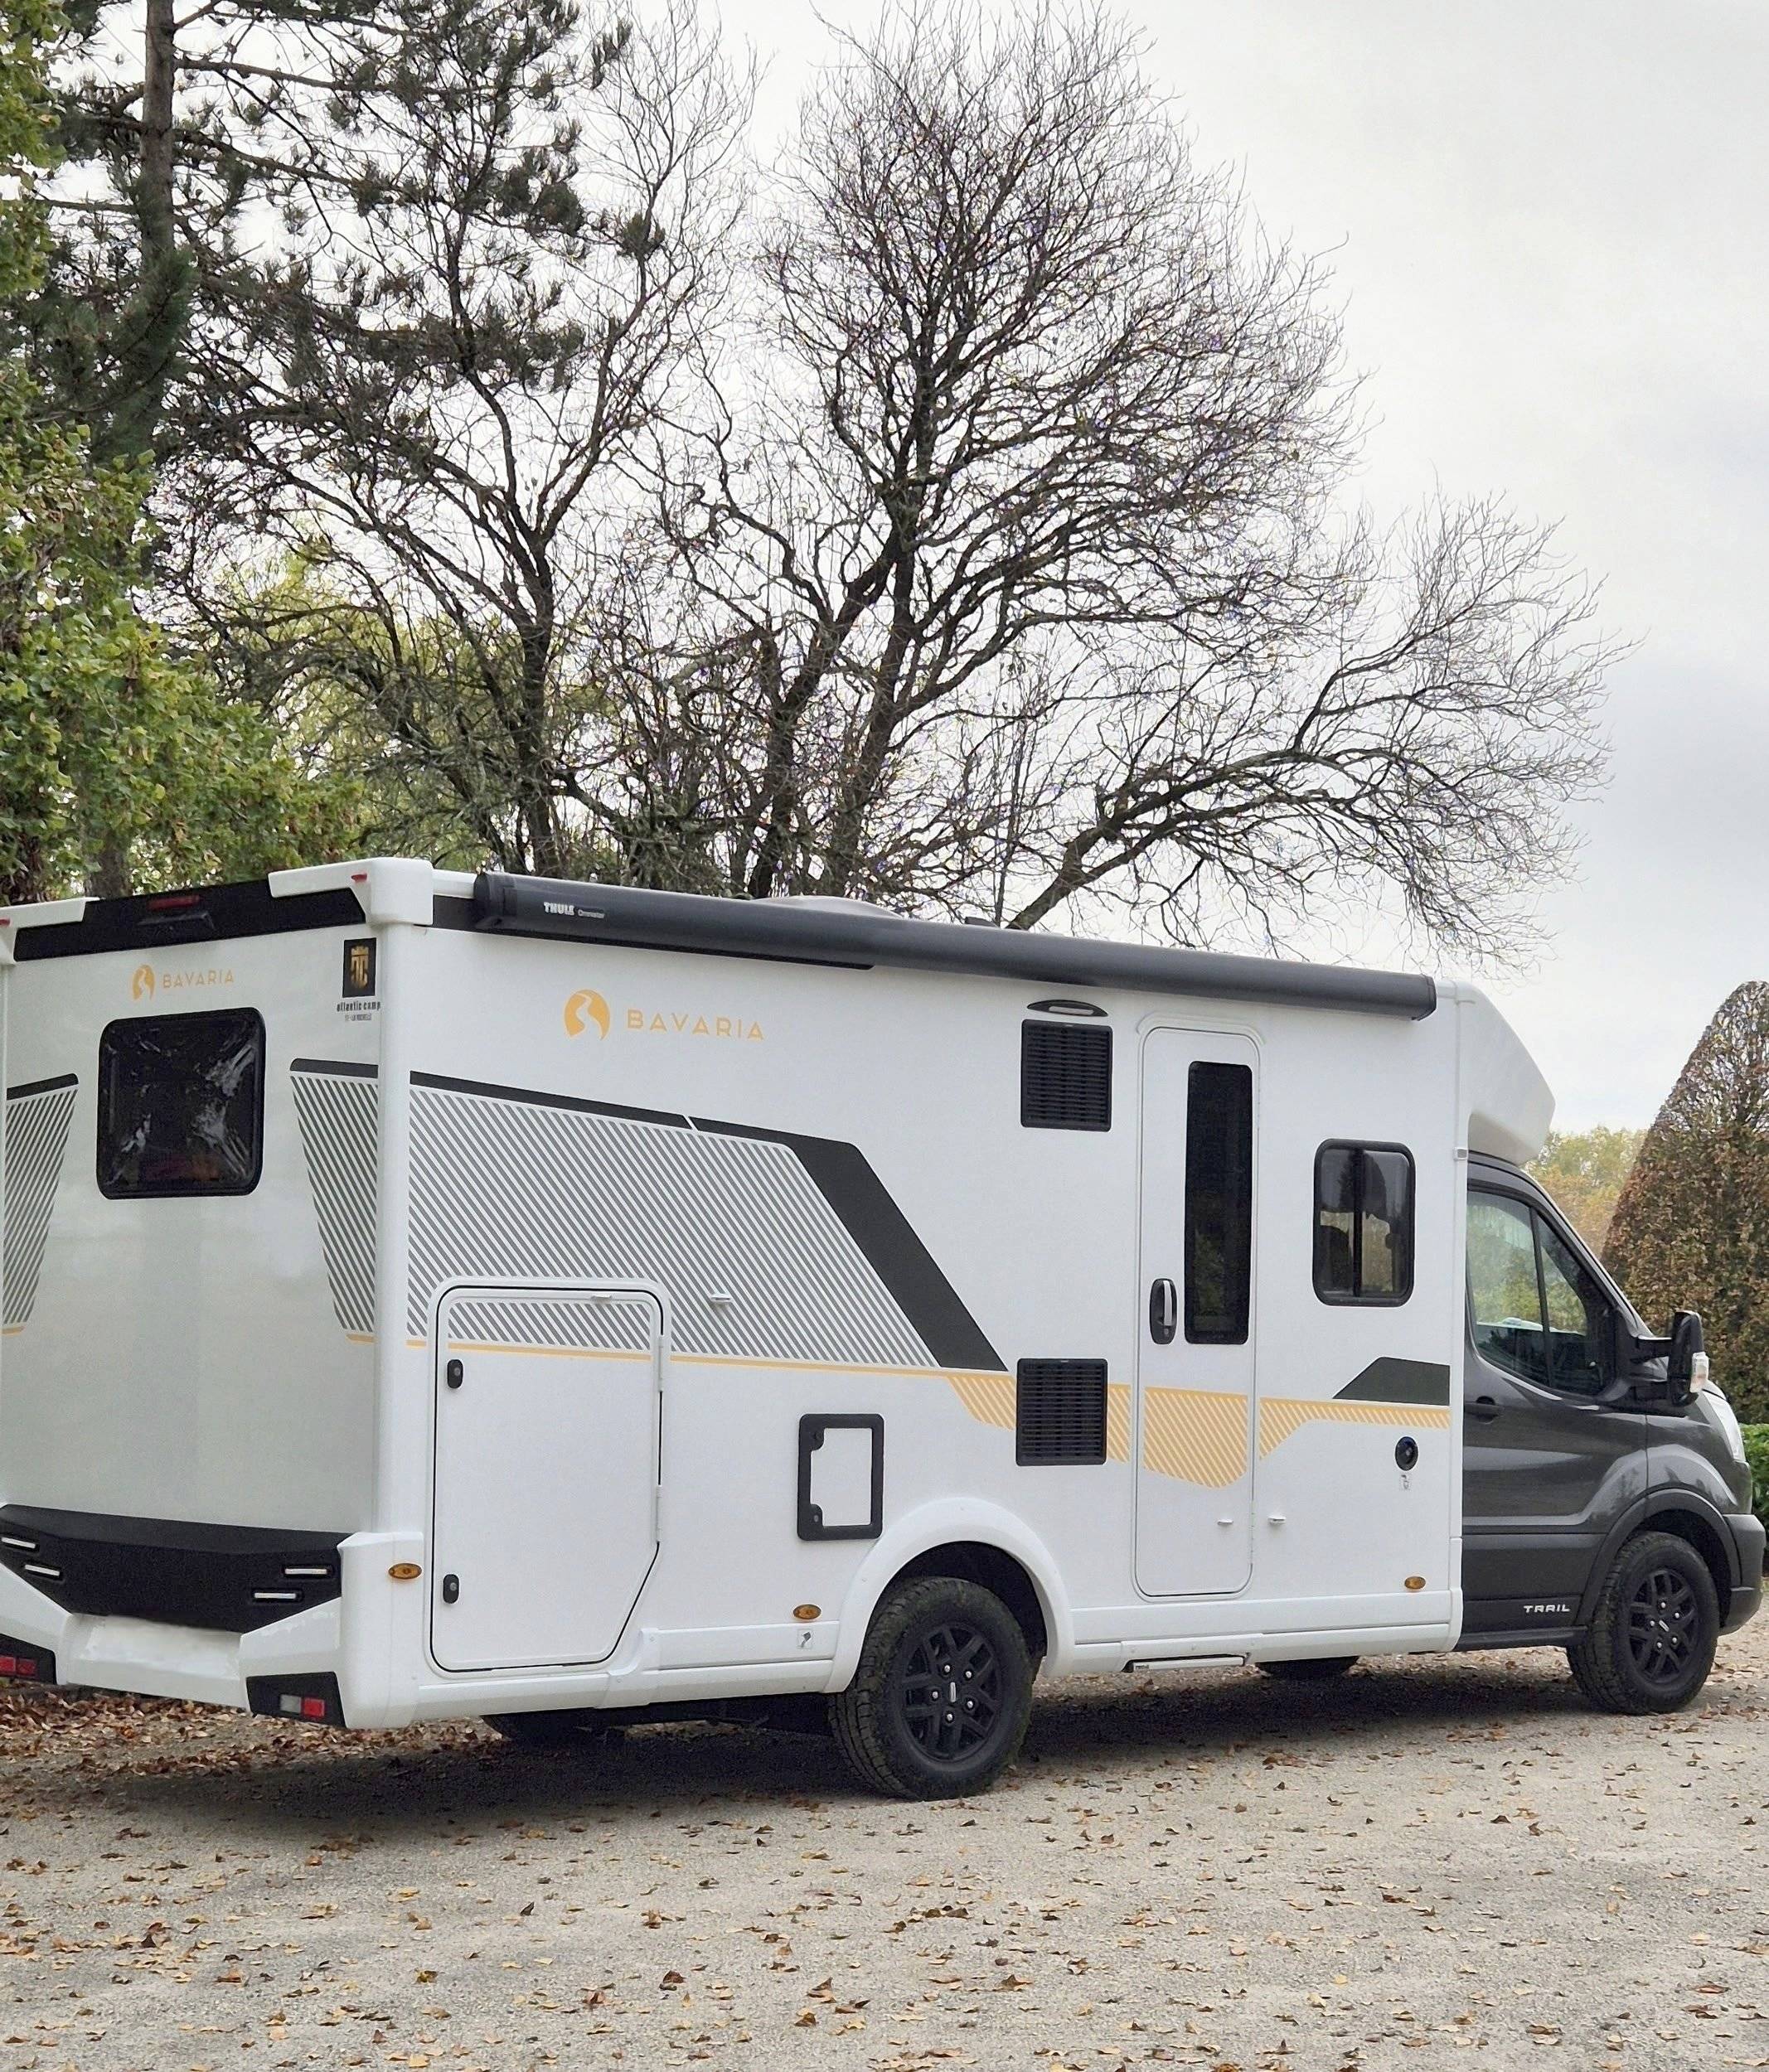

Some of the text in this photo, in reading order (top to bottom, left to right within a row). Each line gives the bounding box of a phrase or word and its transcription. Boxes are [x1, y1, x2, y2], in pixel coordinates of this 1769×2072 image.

[544, 901, 574, 916] THULE
[162, 969, 234, 988] BAVARIA
[363, 1001, 381, 1011] camp
[628, 1009, 764, 1040] BAVARIA
[1523, 1604, 1571, 1614] TRAIL
